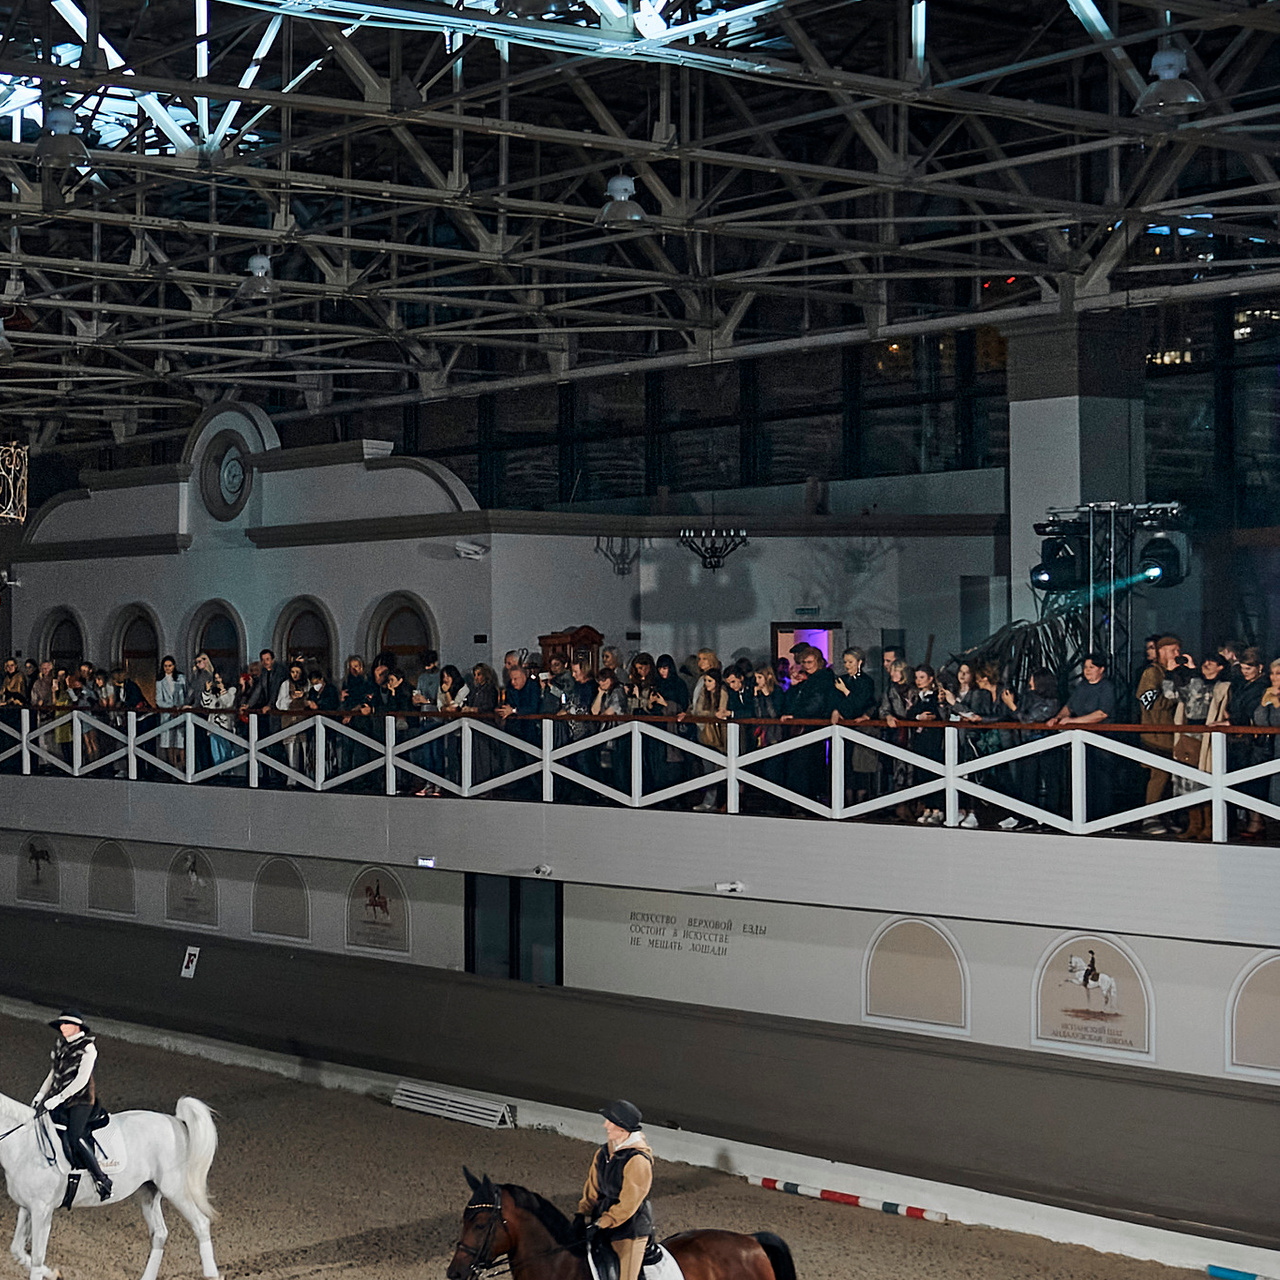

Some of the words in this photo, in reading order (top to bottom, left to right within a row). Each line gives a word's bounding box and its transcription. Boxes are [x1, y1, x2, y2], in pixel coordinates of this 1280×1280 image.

[629, 911, 677, 925] ИСКУССТВО
[687, 917, 733, 931] ВЕРХОВОЙ
[742, 923, 767, 935] ЕЗДЫ
[629, 923, 667, 937] СОСТОИТ
[673, 929, 678, 937] В
[682, 929, 729, 944] ИСКУССТВЕ
[629, 936, 641, 946] НЕ
[648, 938, 683, 951] МЕШАТЬ
[688, 942, 728, 956] ЛОШАДИ
[184, 952, 196, 970] F
